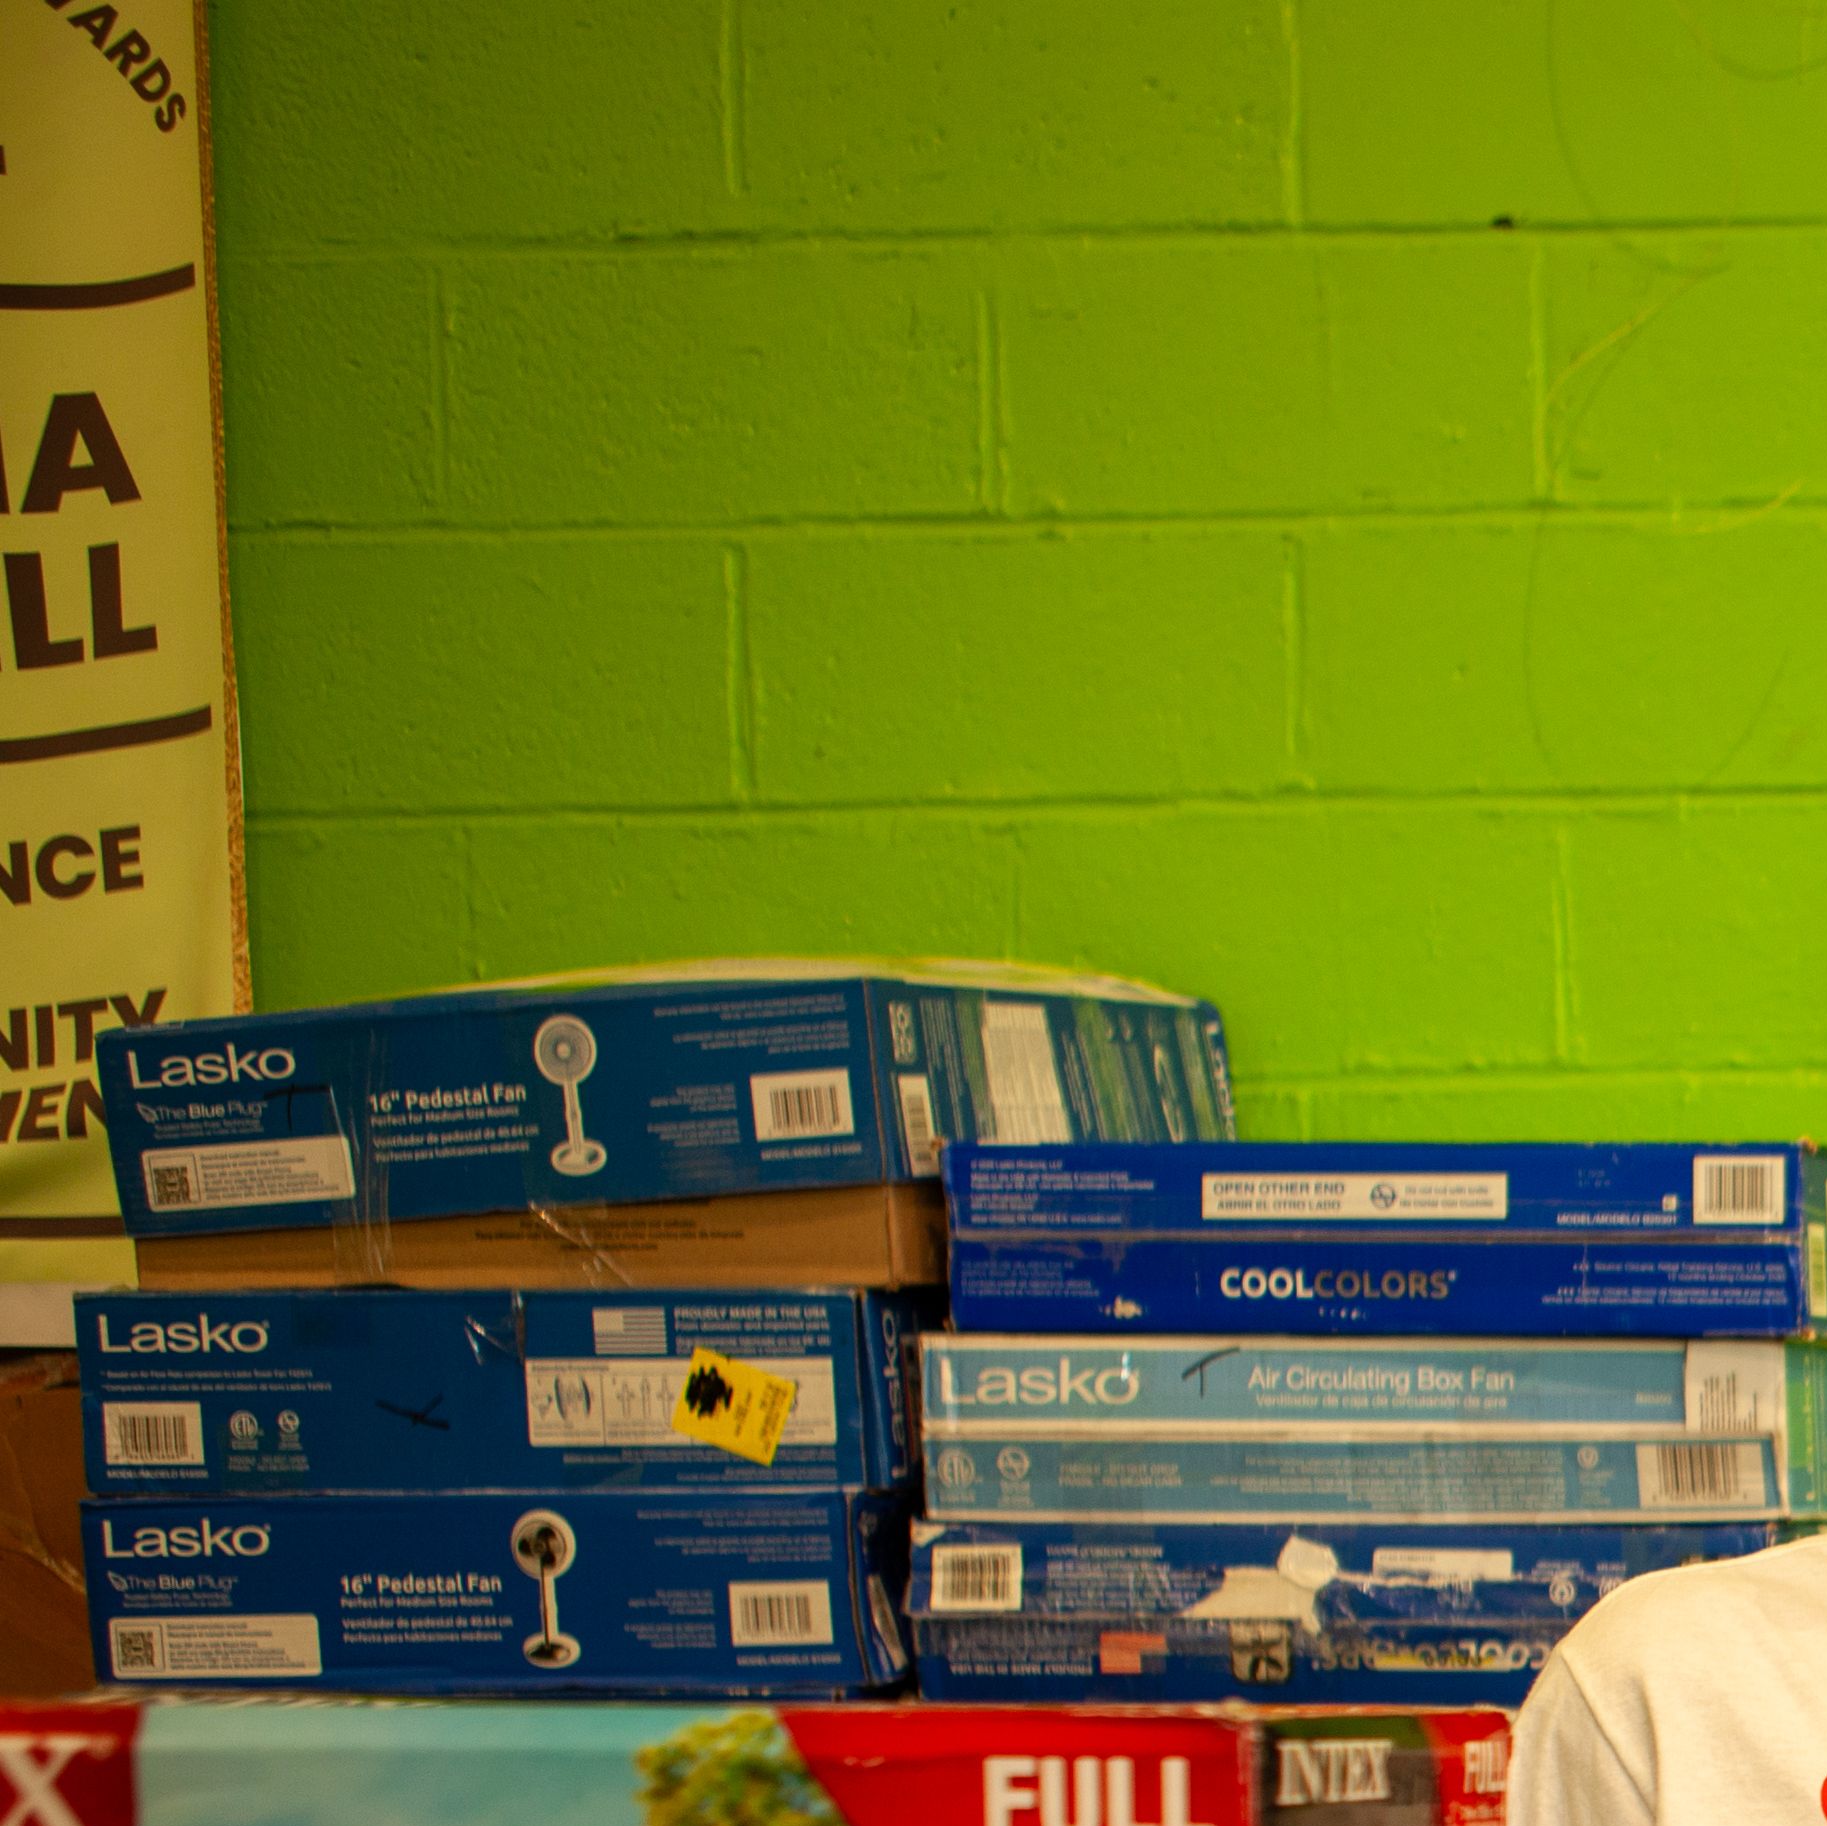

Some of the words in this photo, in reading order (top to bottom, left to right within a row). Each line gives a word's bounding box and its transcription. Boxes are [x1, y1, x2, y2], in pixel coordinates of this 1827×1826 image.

[45, 0, 186, 133] ARDS
[128, 1042, 297, 1091] Lasko
[188, 1102, 226, 1119] Blue
[404, 1081, 489, 1110] Pedestal
[492, 1082, 527, 1103] Fan
[1213, 1181, 1256, 1197] OPEN
[1258, 1181, 1311, 1197] OTHER
[1313, 1181, 1346, 1196] END
[98, 1312, 269, 1355] Lasko
[939, 1354, 1140, 1406] Lasko
[1248, 1364, 1281, 1390] Air
[1285, 1364, 1410, 1396] Circulating
[1416, 1365, 1465, 1391] Box
[1470, 1365, 1515, 1391] Fan
[102, 1516, 270, 1559] Lasko
[158, 1574, 195, 1590] Blue
[376, 1571, 463, 1595] Pedestal
[466, 1572, 503, 1594] Fan
